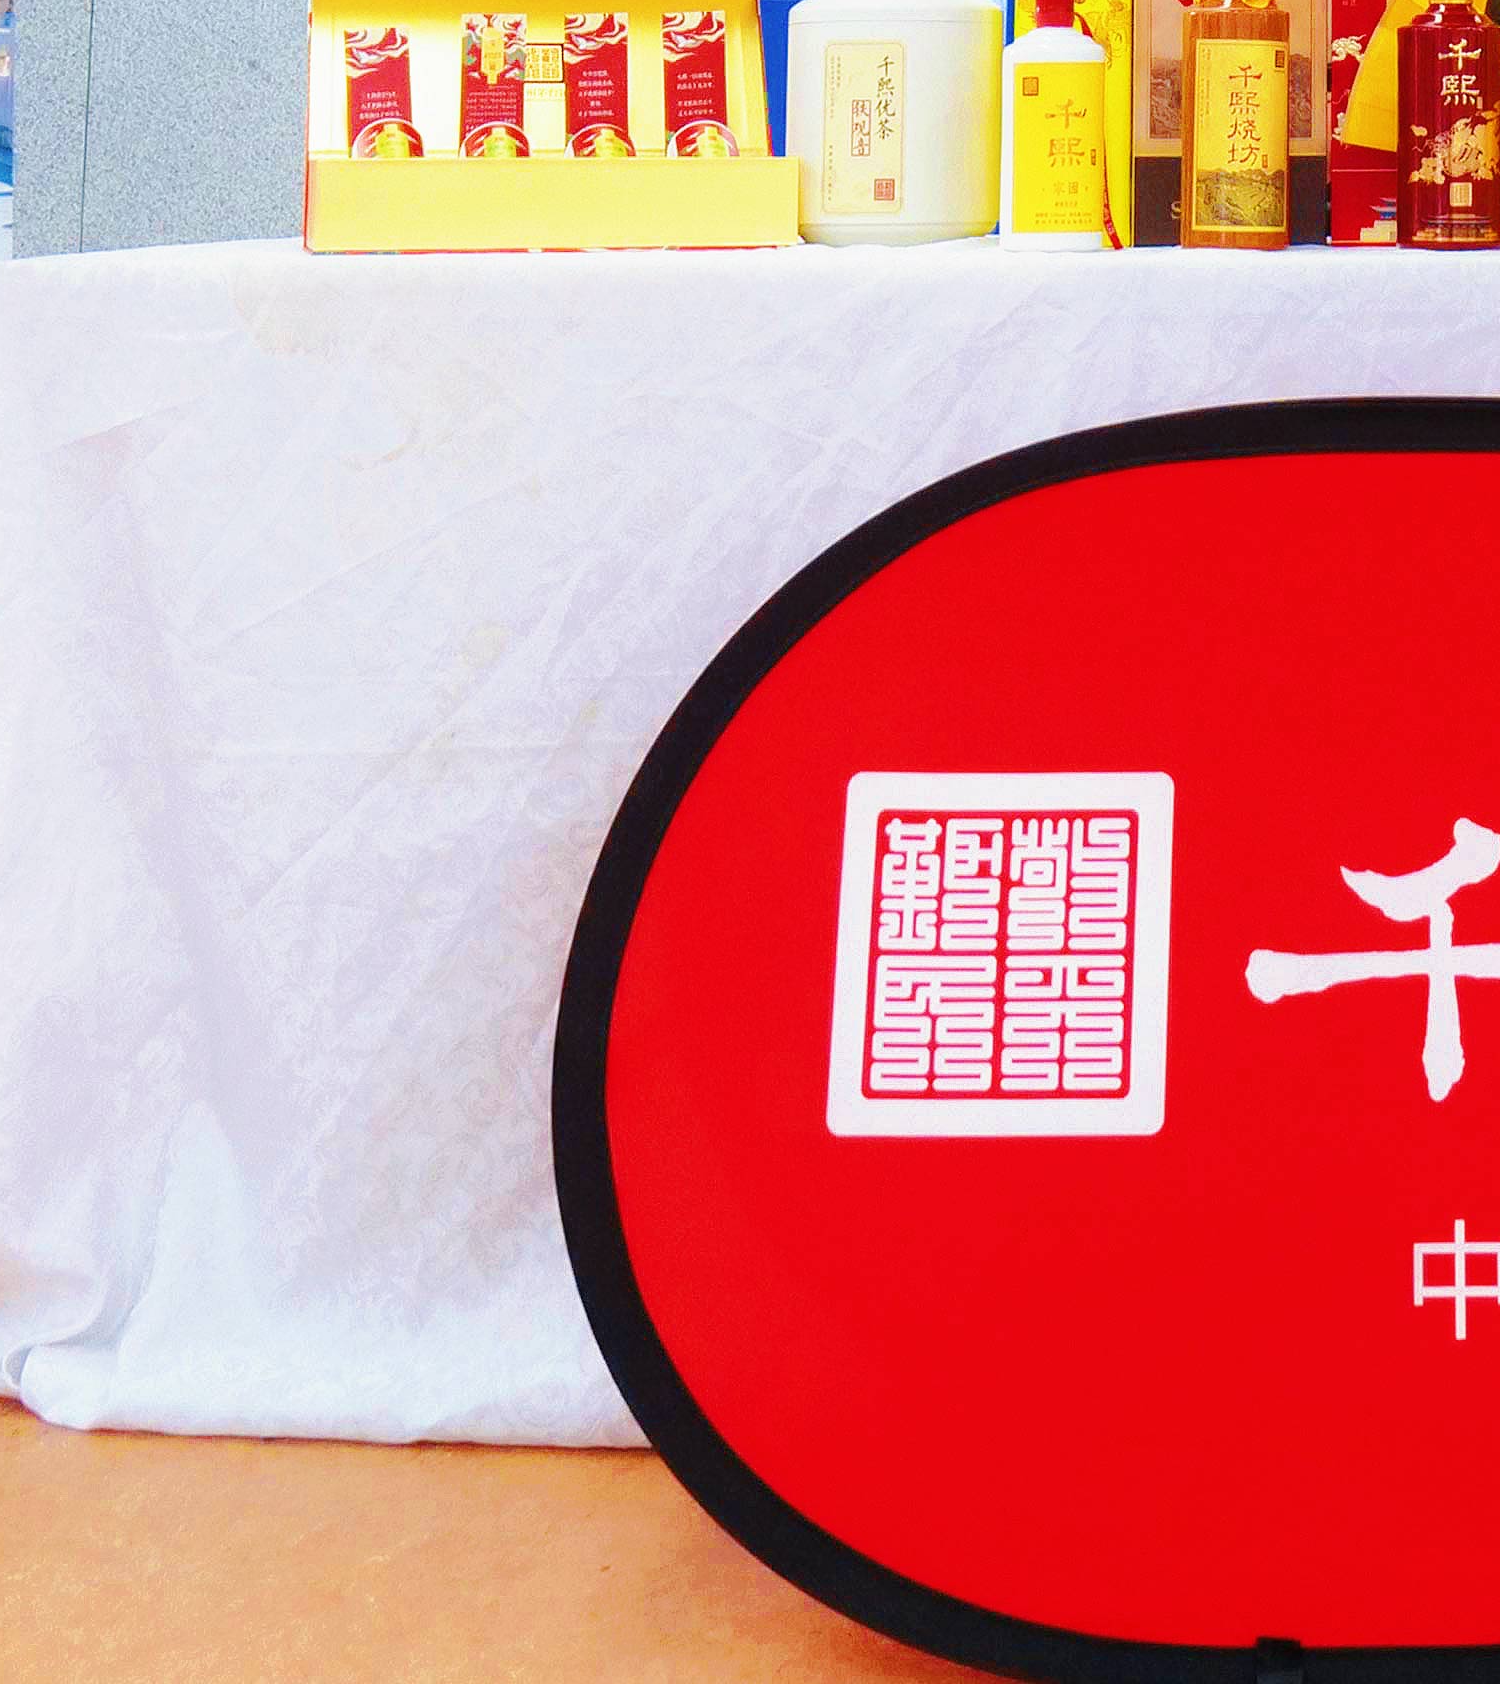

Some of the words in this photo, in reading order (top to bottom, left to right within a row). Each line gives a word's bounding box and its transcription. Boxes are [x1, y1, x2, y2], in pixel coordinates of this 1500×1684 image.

[1438, 37, 1482, 106] 千熙
[1045, 99, 1088, 168] 千熙
[1227, 64, 1263, 167] 千熙烧坊
